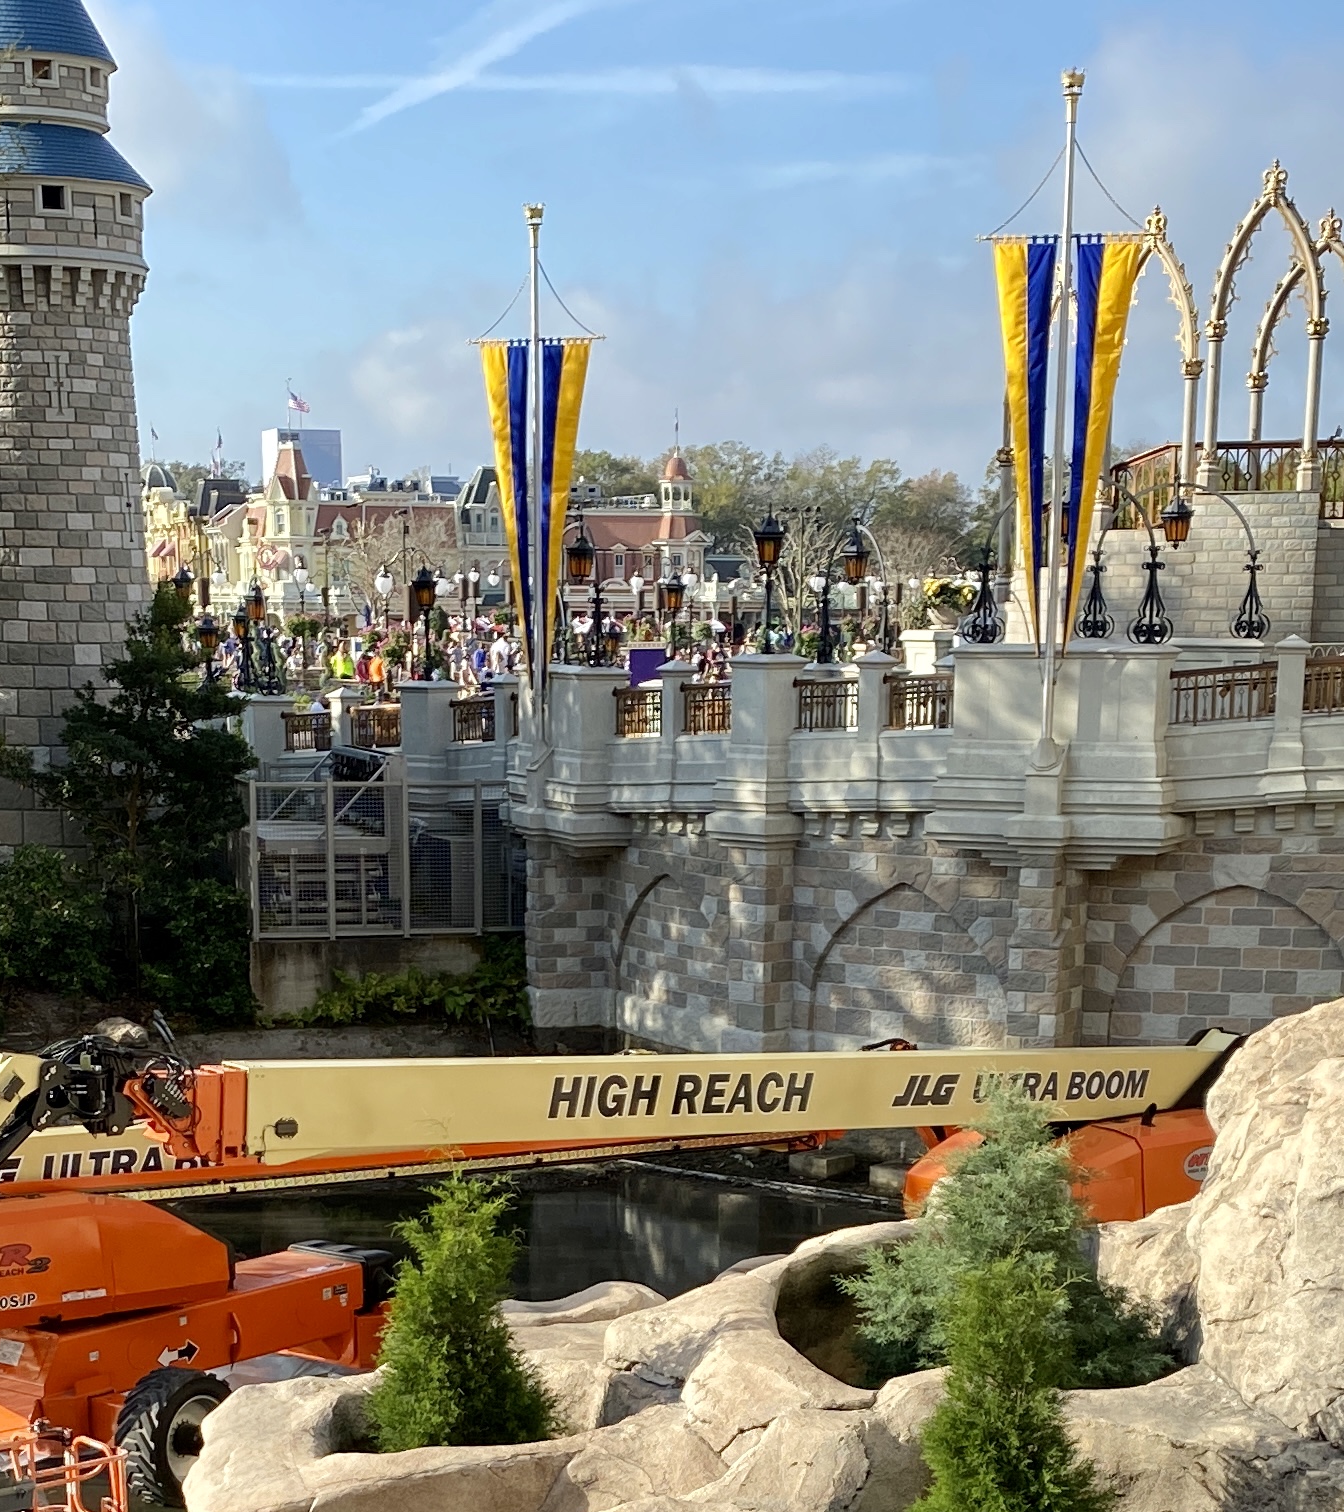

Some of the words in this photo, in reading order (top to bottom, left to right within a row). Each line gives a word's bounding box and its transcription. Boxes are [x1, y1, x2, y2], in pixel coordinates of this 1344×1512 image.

[547, 1074, 662, 1119] HIGH
[670, 1071, 814, 1115] REACH
[891, 1073, 960, 1108] JLG
[1065, 1069, 1150, 1101] BOOM
